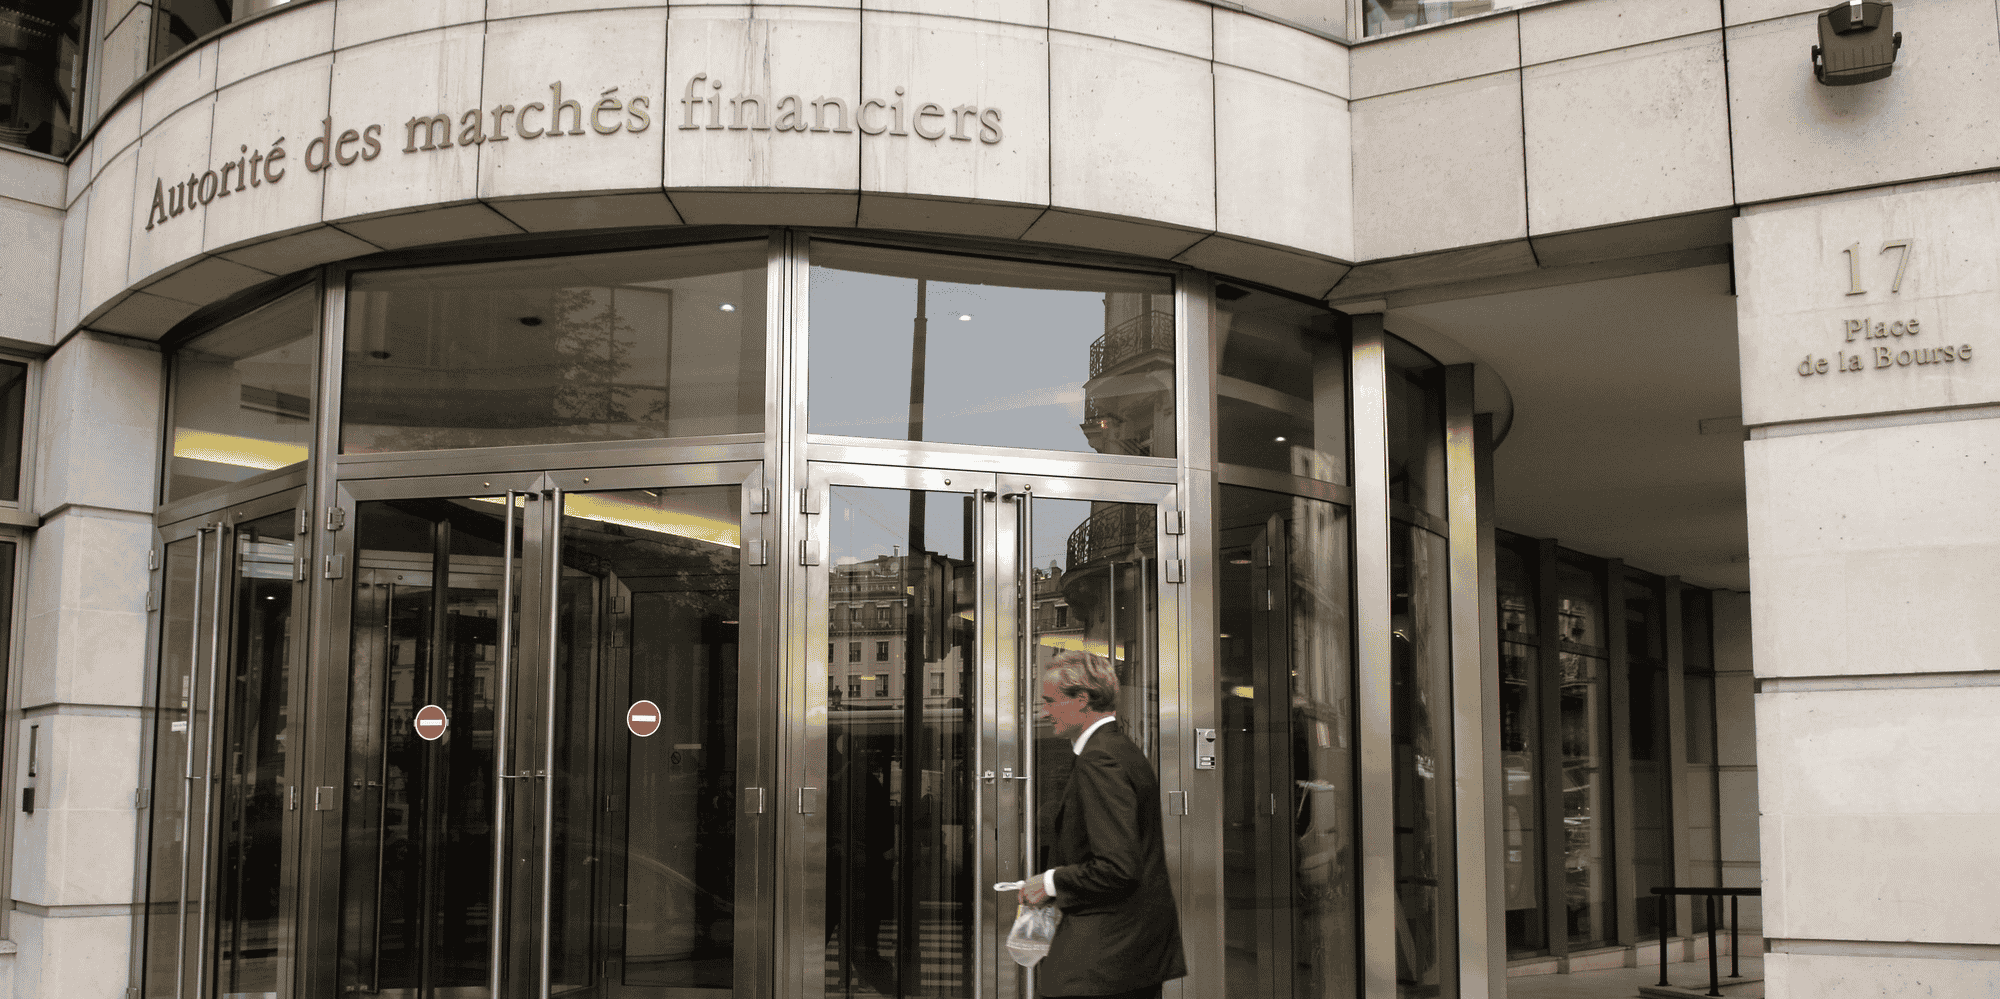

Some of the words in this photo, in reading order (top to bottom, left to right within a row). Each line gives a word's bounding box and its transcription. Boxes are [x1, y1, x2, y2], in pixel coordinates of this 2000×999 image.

[145, 136, 286, 231] Autorité
[304, 116, 382, 173] des
[402, 80, 651, 153] marchés
[678, 72, 1004, 144] financiers
[1842, 238, 1913, 296] 17
[1844, 317, 1921, 342] Place
[1797, 354, 1829, 377] de
[1838, 350, 1864, 373] la
[1872, 343, 1973, 370] Bourse
